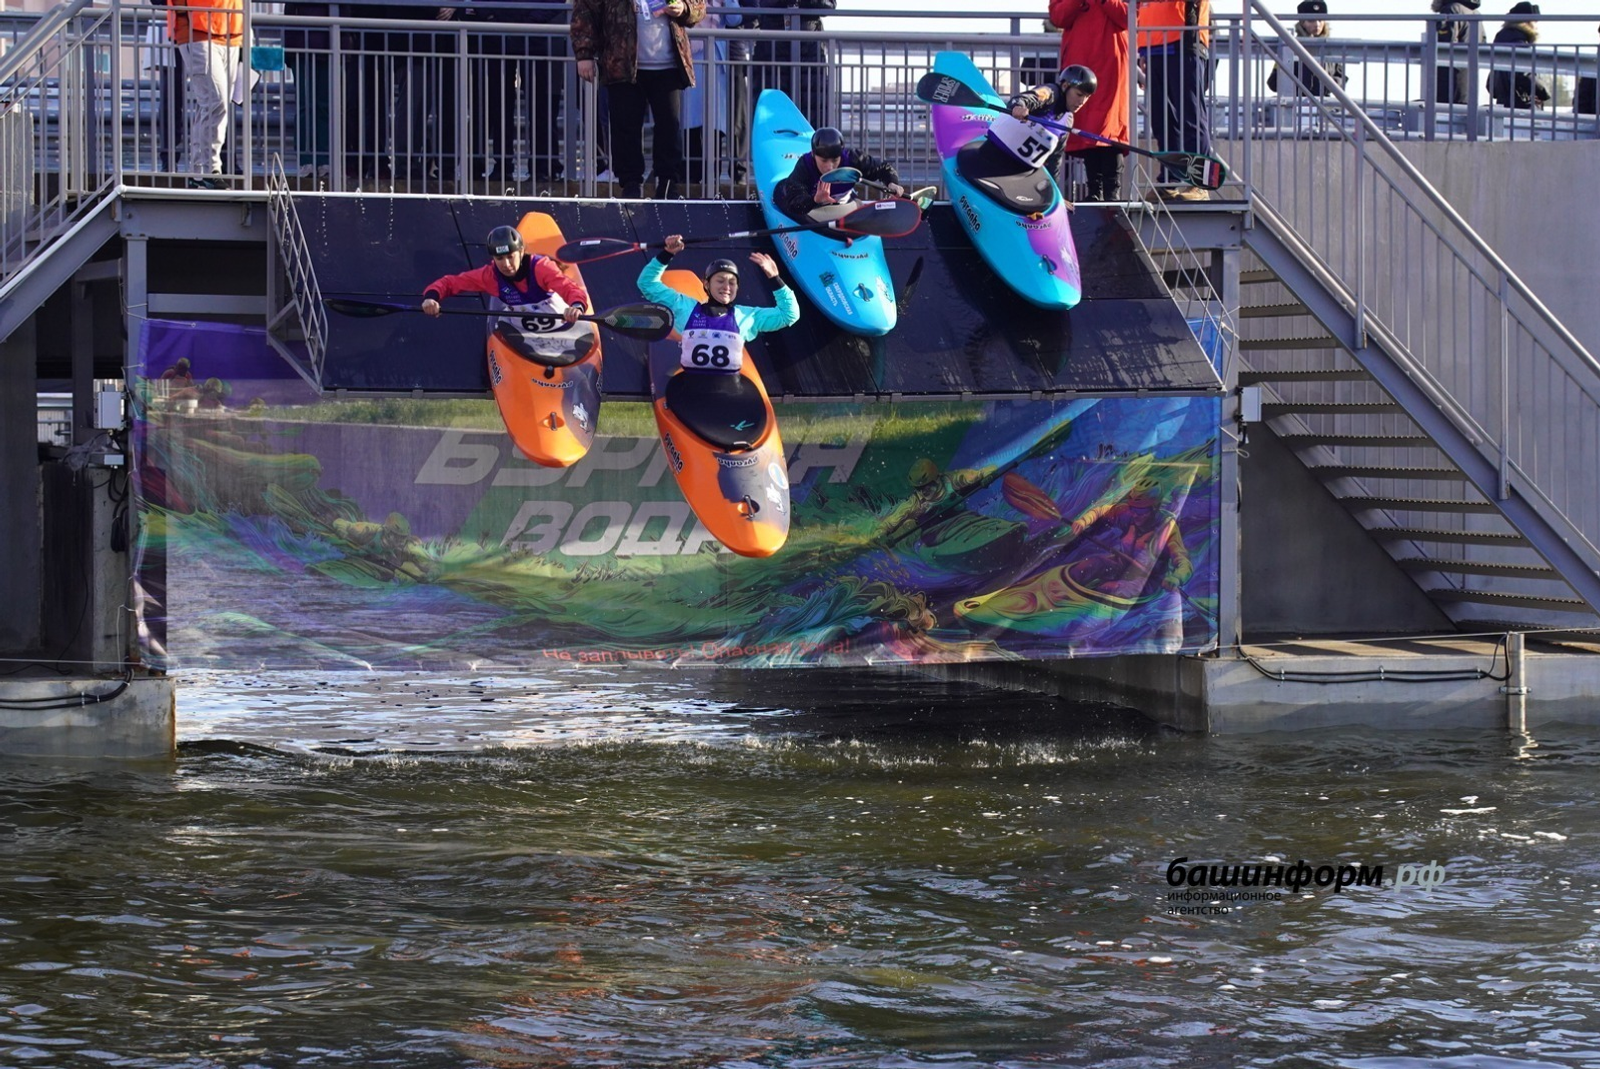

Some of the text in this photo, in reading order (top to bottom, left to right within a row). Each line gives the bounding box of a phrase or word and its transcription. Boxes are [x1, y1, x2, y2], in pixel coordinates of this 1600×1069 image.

[1017, 136, 1050, 163] 57
[521, 316, 556, 333] 69
[691, 344, 730, 367] 68
[542, 648, 572, 660] Не
[701, 640, 791, 660] Опасная
